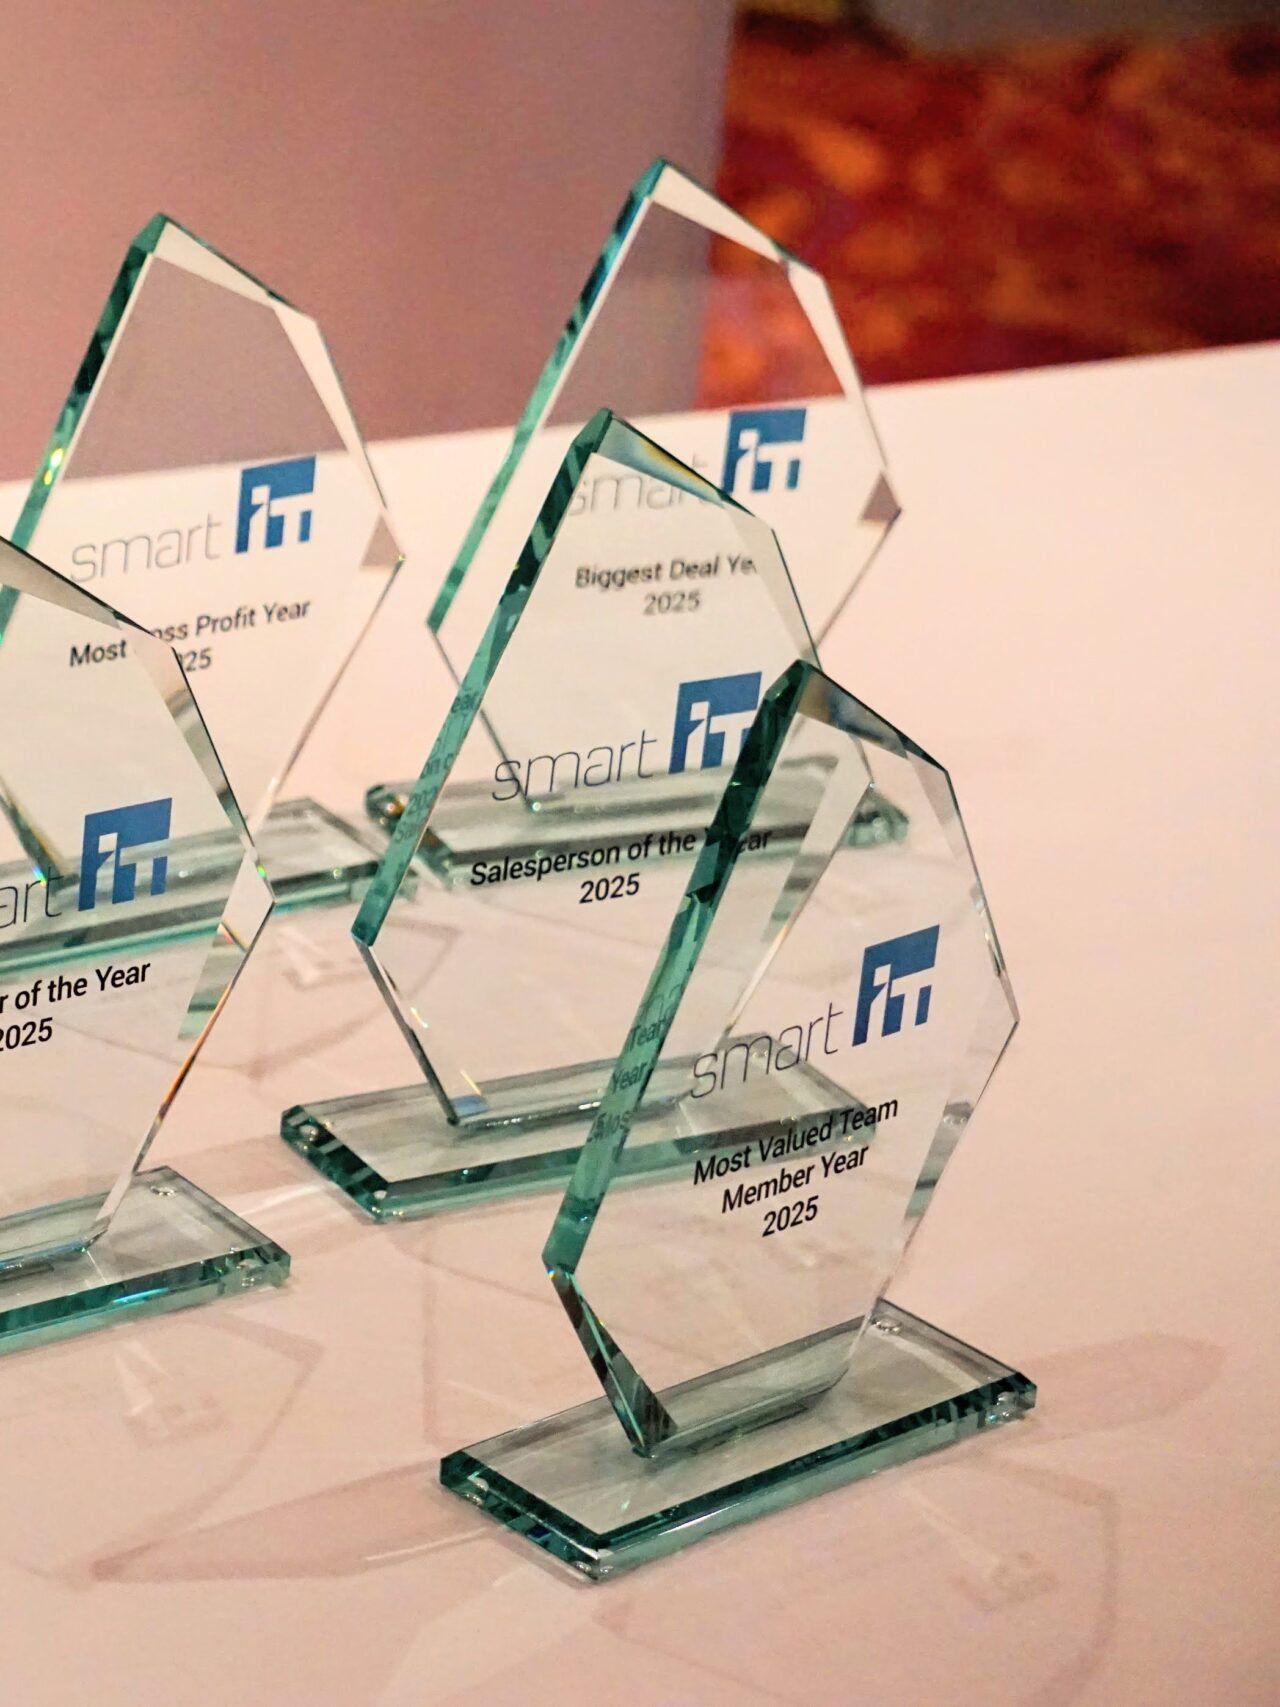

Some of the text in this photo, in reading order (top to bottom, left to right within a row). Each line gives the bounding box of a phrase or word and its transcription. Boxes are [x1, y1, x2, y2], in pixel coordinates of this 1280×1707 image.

[570, 453, 708, 515] sma
[71, 513, 222, 583] smart
[575, 552, 757, 590] Biggest Deal Ye
[643, 590, 701, 616] 2025
[69, 600, 311, 667] Most oss Profit Year
[177, 647, 211, 672] 25
[491, 729, 658, 801] smart
[470, 830, 772, 886] Salesperson of the ear
[578, 872, 641, 904] 2025
[15, 981, 43, 1010] of
[47, 975, 88, 1003] the
[95, 962, 151, 992] Year
[690, 1002, 844, 1099] smart
[693, 1099, 899, 1185] Most Valued Team
[721, 1146, 869, 1214] Member Year
[762, 1195, 819, 1238] 2025
